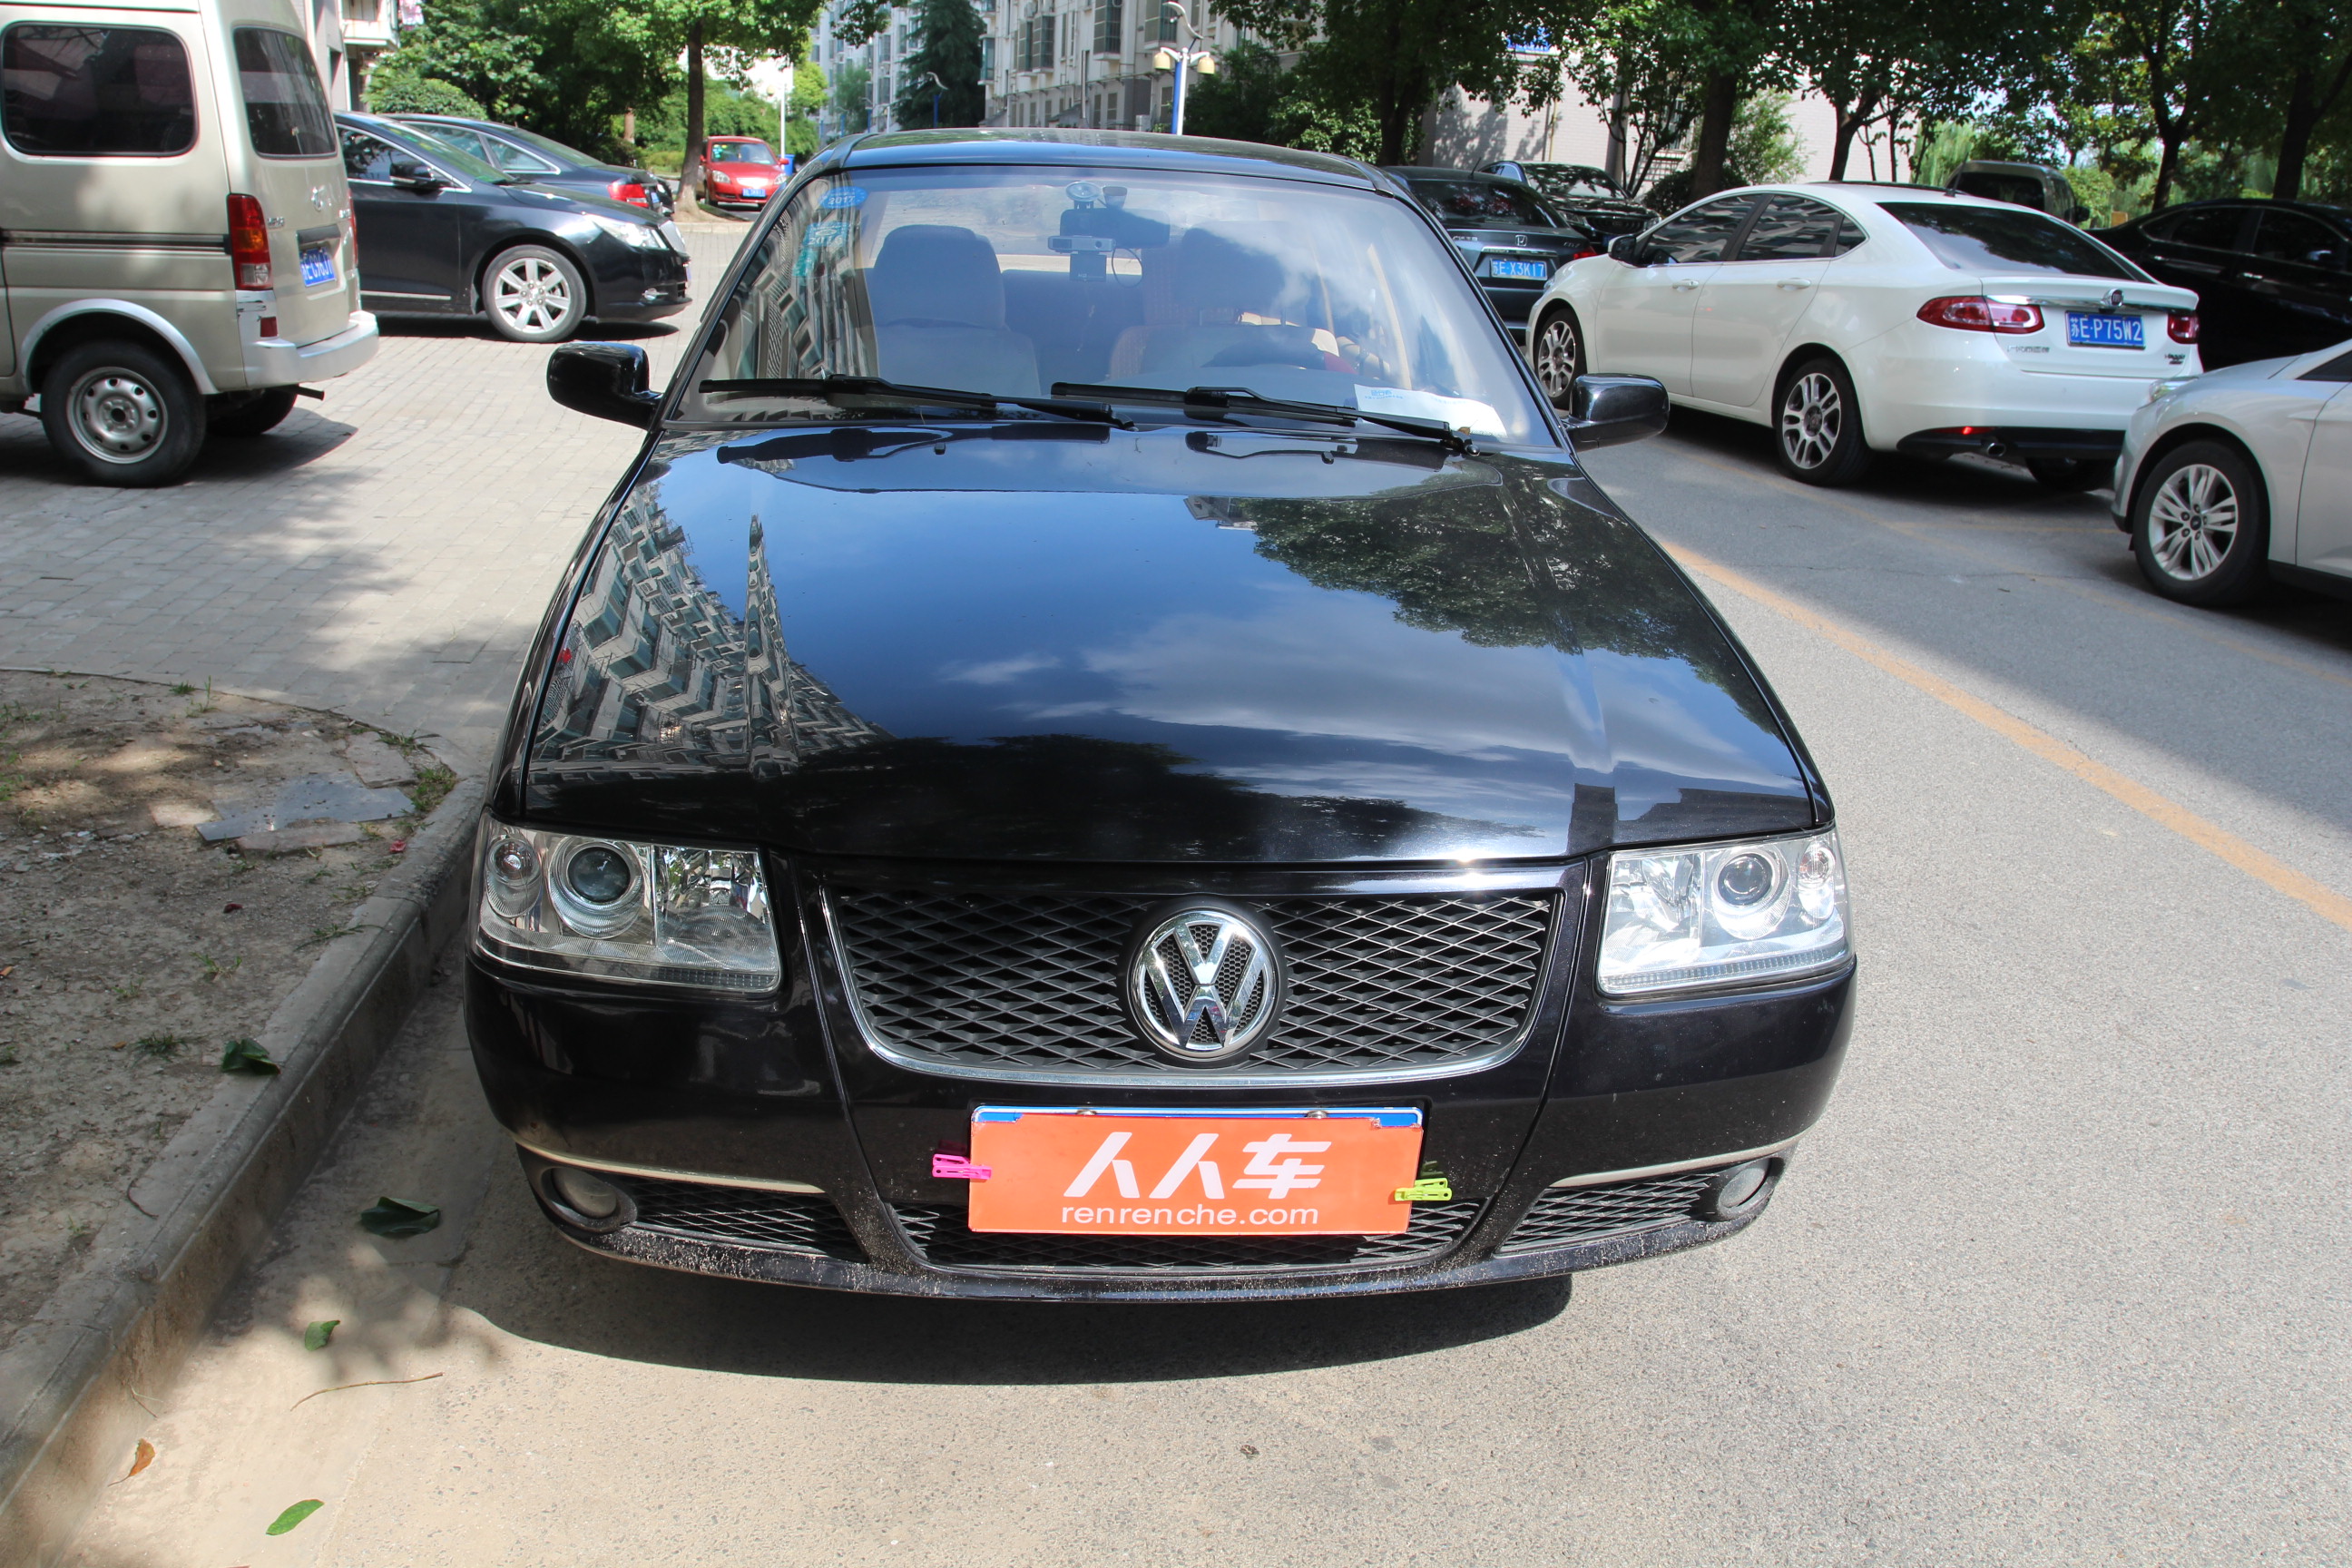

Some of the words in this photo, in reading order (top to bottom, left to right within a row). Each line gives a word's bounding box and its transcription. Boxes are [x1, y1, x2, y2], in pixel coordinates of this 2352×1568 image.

[828, 196, 855, 204] 2017
[1063, 1131, 1332, 1199] 人人车
[1062, 1202, 1319, 1226] renrenche.com
